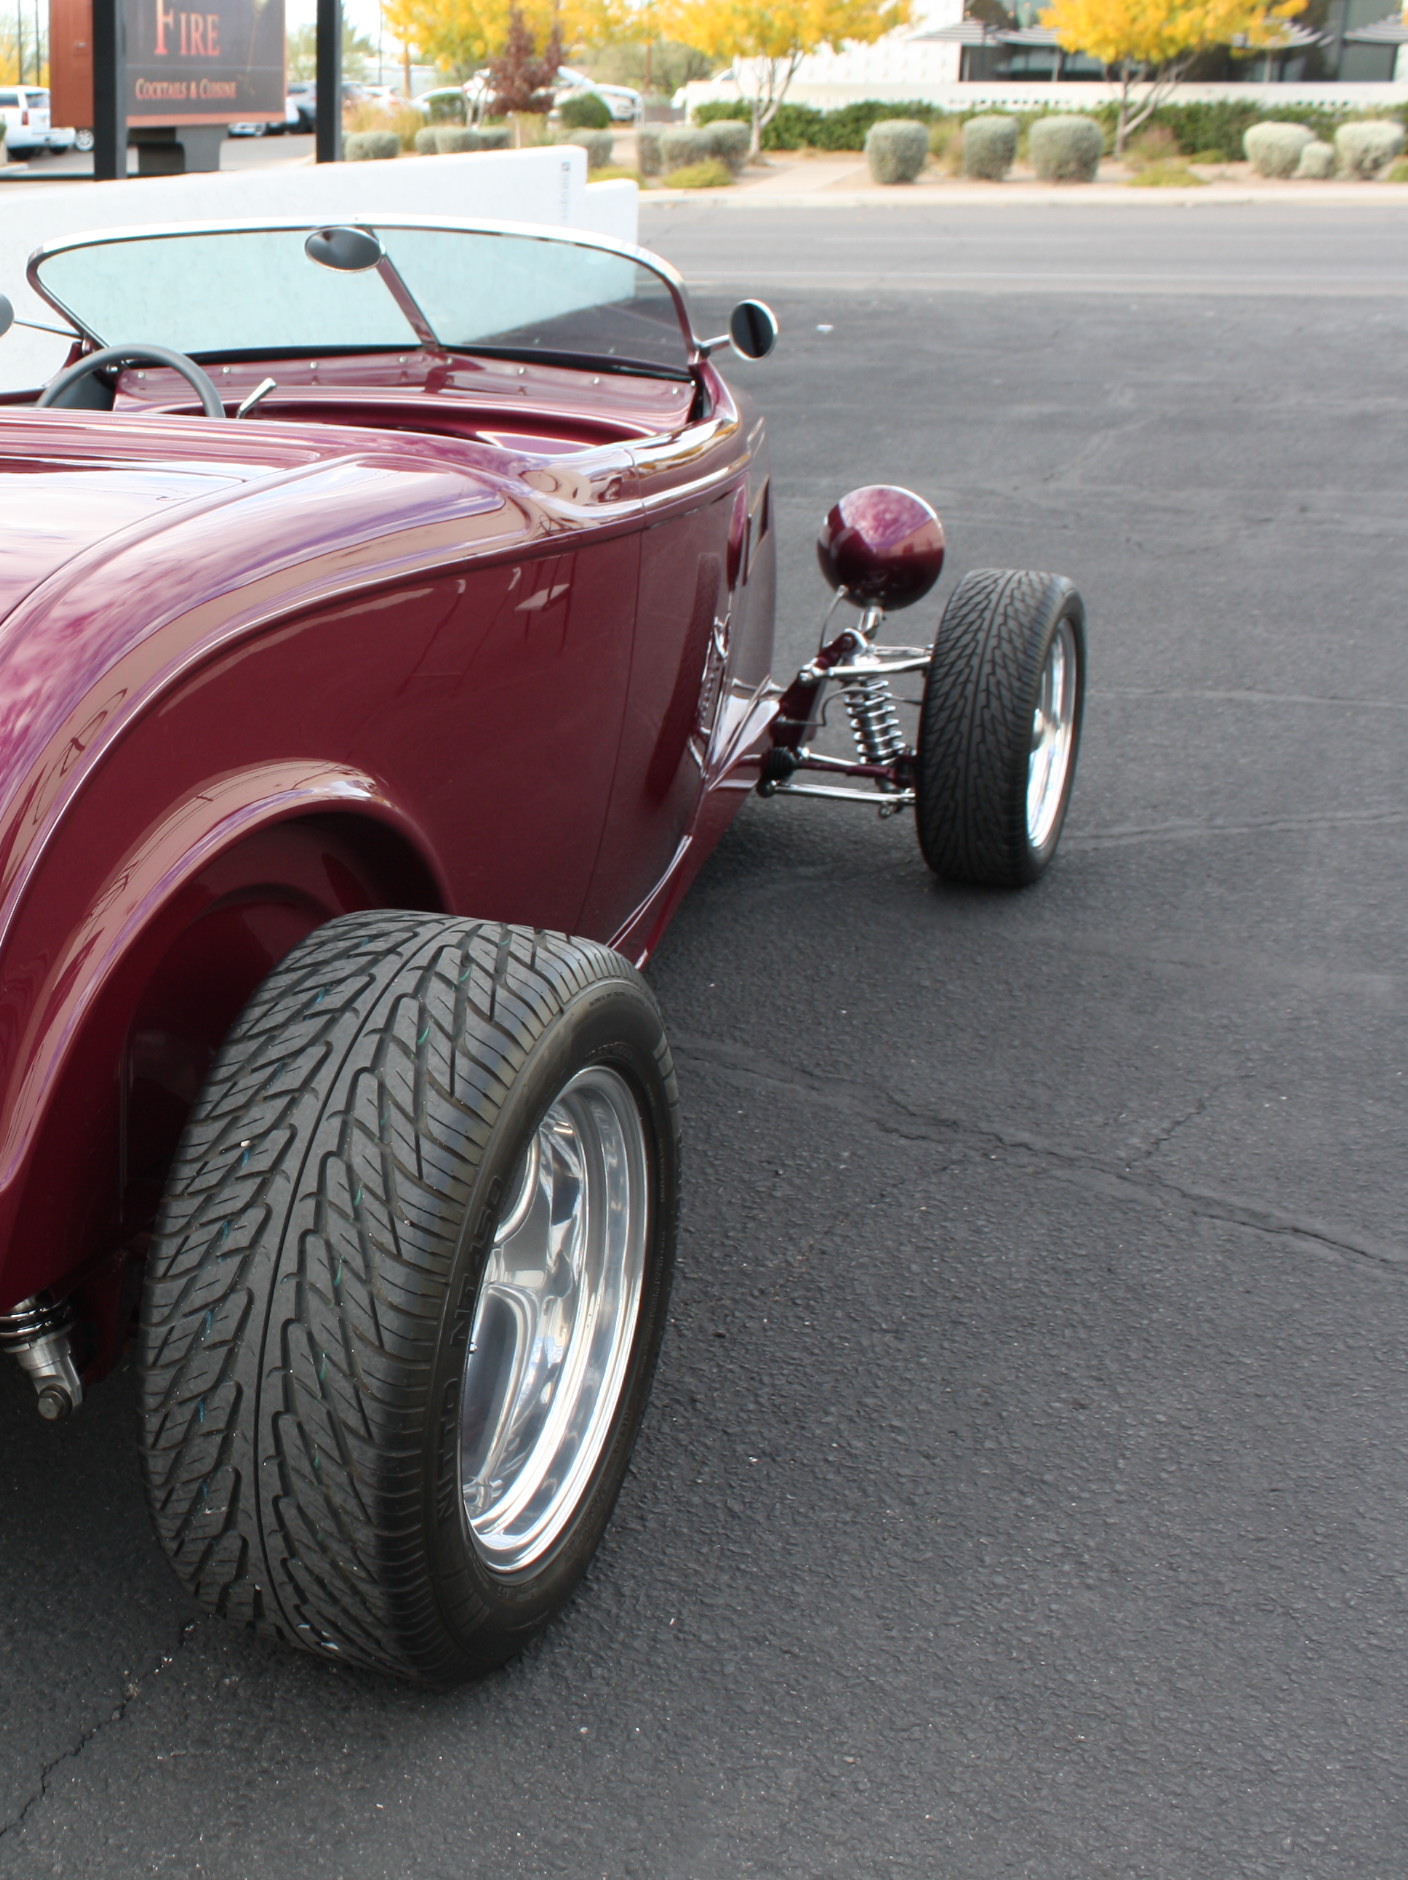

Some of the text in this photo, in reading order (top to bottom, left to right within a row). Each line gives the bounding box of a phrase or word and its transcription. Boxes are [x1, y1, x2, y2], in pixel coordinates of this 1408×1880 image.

[154, 0, 221, 56] FIRE
[135, 78, 187, 99] COCKTAILS
[199, 78, 237, 99] CUISINE
